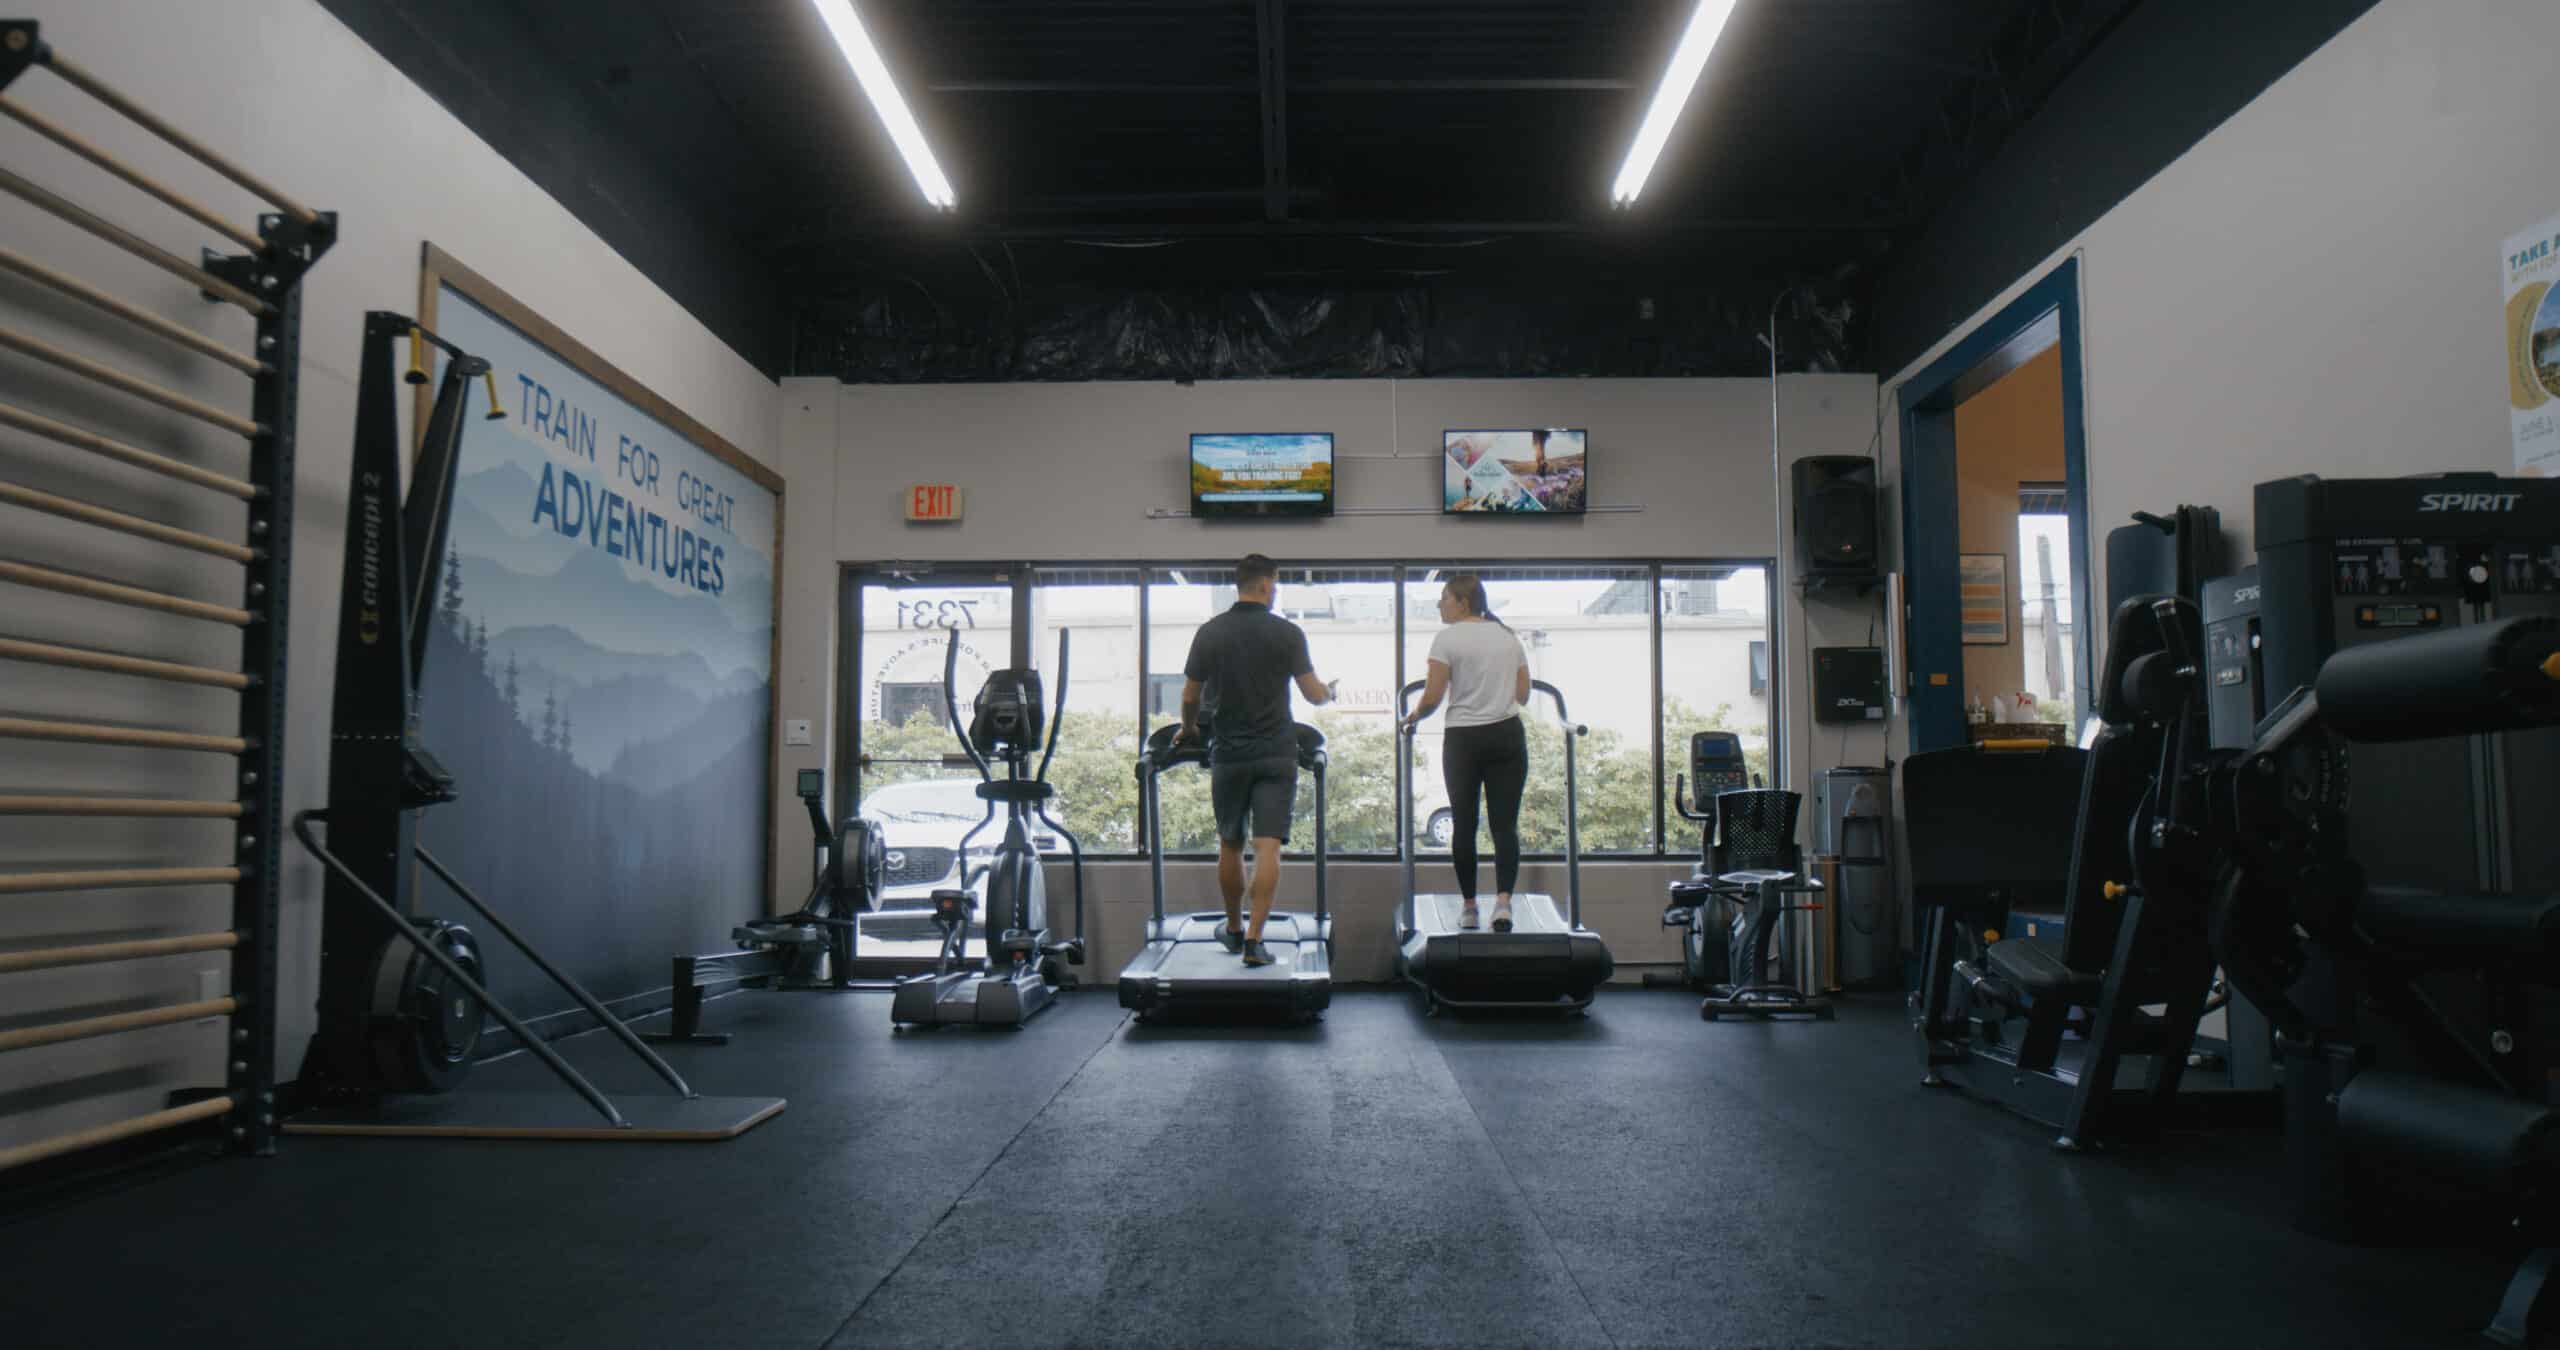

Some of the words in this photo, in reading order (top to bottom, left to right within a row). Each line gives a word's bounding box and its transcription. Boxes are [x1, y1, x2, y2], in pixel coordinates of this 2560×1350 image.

[2509, 239, 2549, 270] TAKE
[518, 373, 596, 462] TRAIN
[618, 434, 660, 496] FOR
[678, 469, 735, 534] GREAT
[363, 471, 382, 488] 2
[913, 485, 955, 517] EXIT
[2418, 493, 2524, 512] SPIRIT
[532, 461, 724, 597] ADVENTURES
[364, 495, 382, 605] concept
[2233, 585, 2260, 603] SPIR
